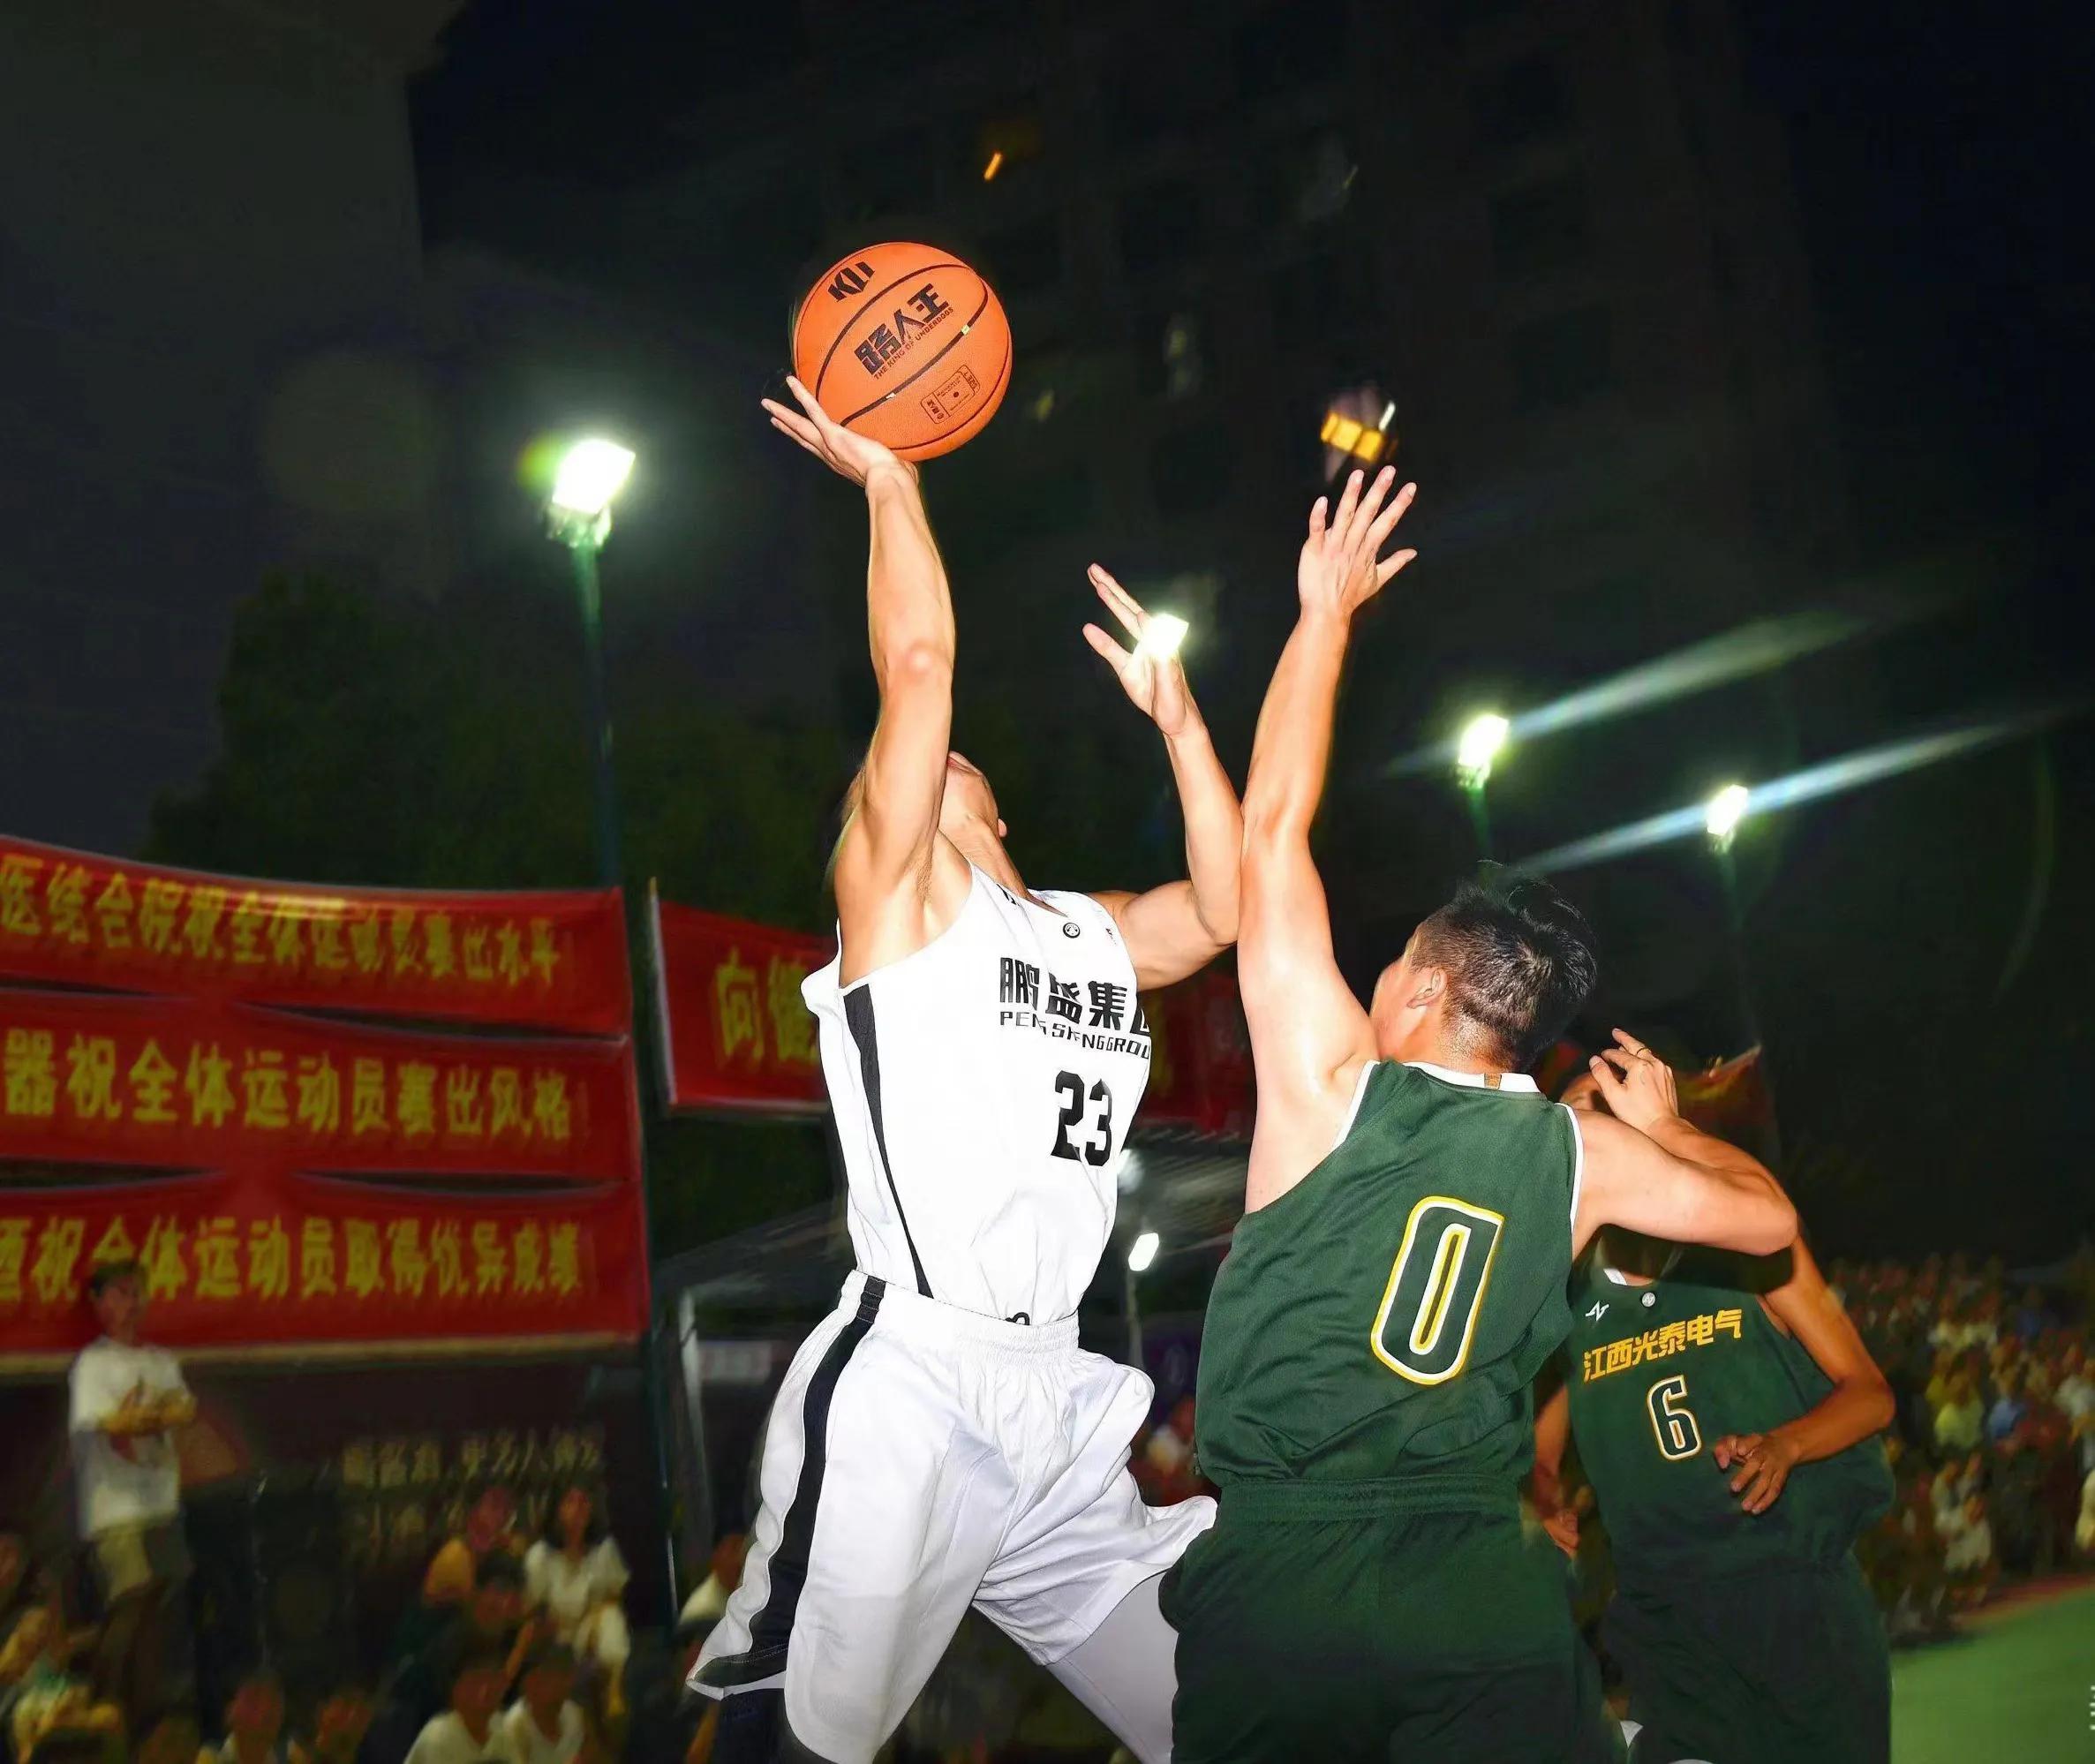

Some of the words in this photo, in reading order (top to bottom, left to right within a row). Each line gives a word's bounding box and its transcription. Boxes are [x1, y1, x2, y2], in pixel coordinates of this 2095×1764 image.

[854, 283, 949, 376] 路人王
[873, 366, 888, 381] THE
[886, 349, 906, 368] KING
[915, 306, 954, 341] UNDERDOGS
[4, 1027, 570, 1139] 器祝全体运动员赛出风格
[1050, 1070, 1112, 1166] 23
[1370, 1195, 1506, 1386] 0
[1583, 1308, 1744, 1383] 江西光泰电气
[1646, 1373, 1703, 1462] 6
